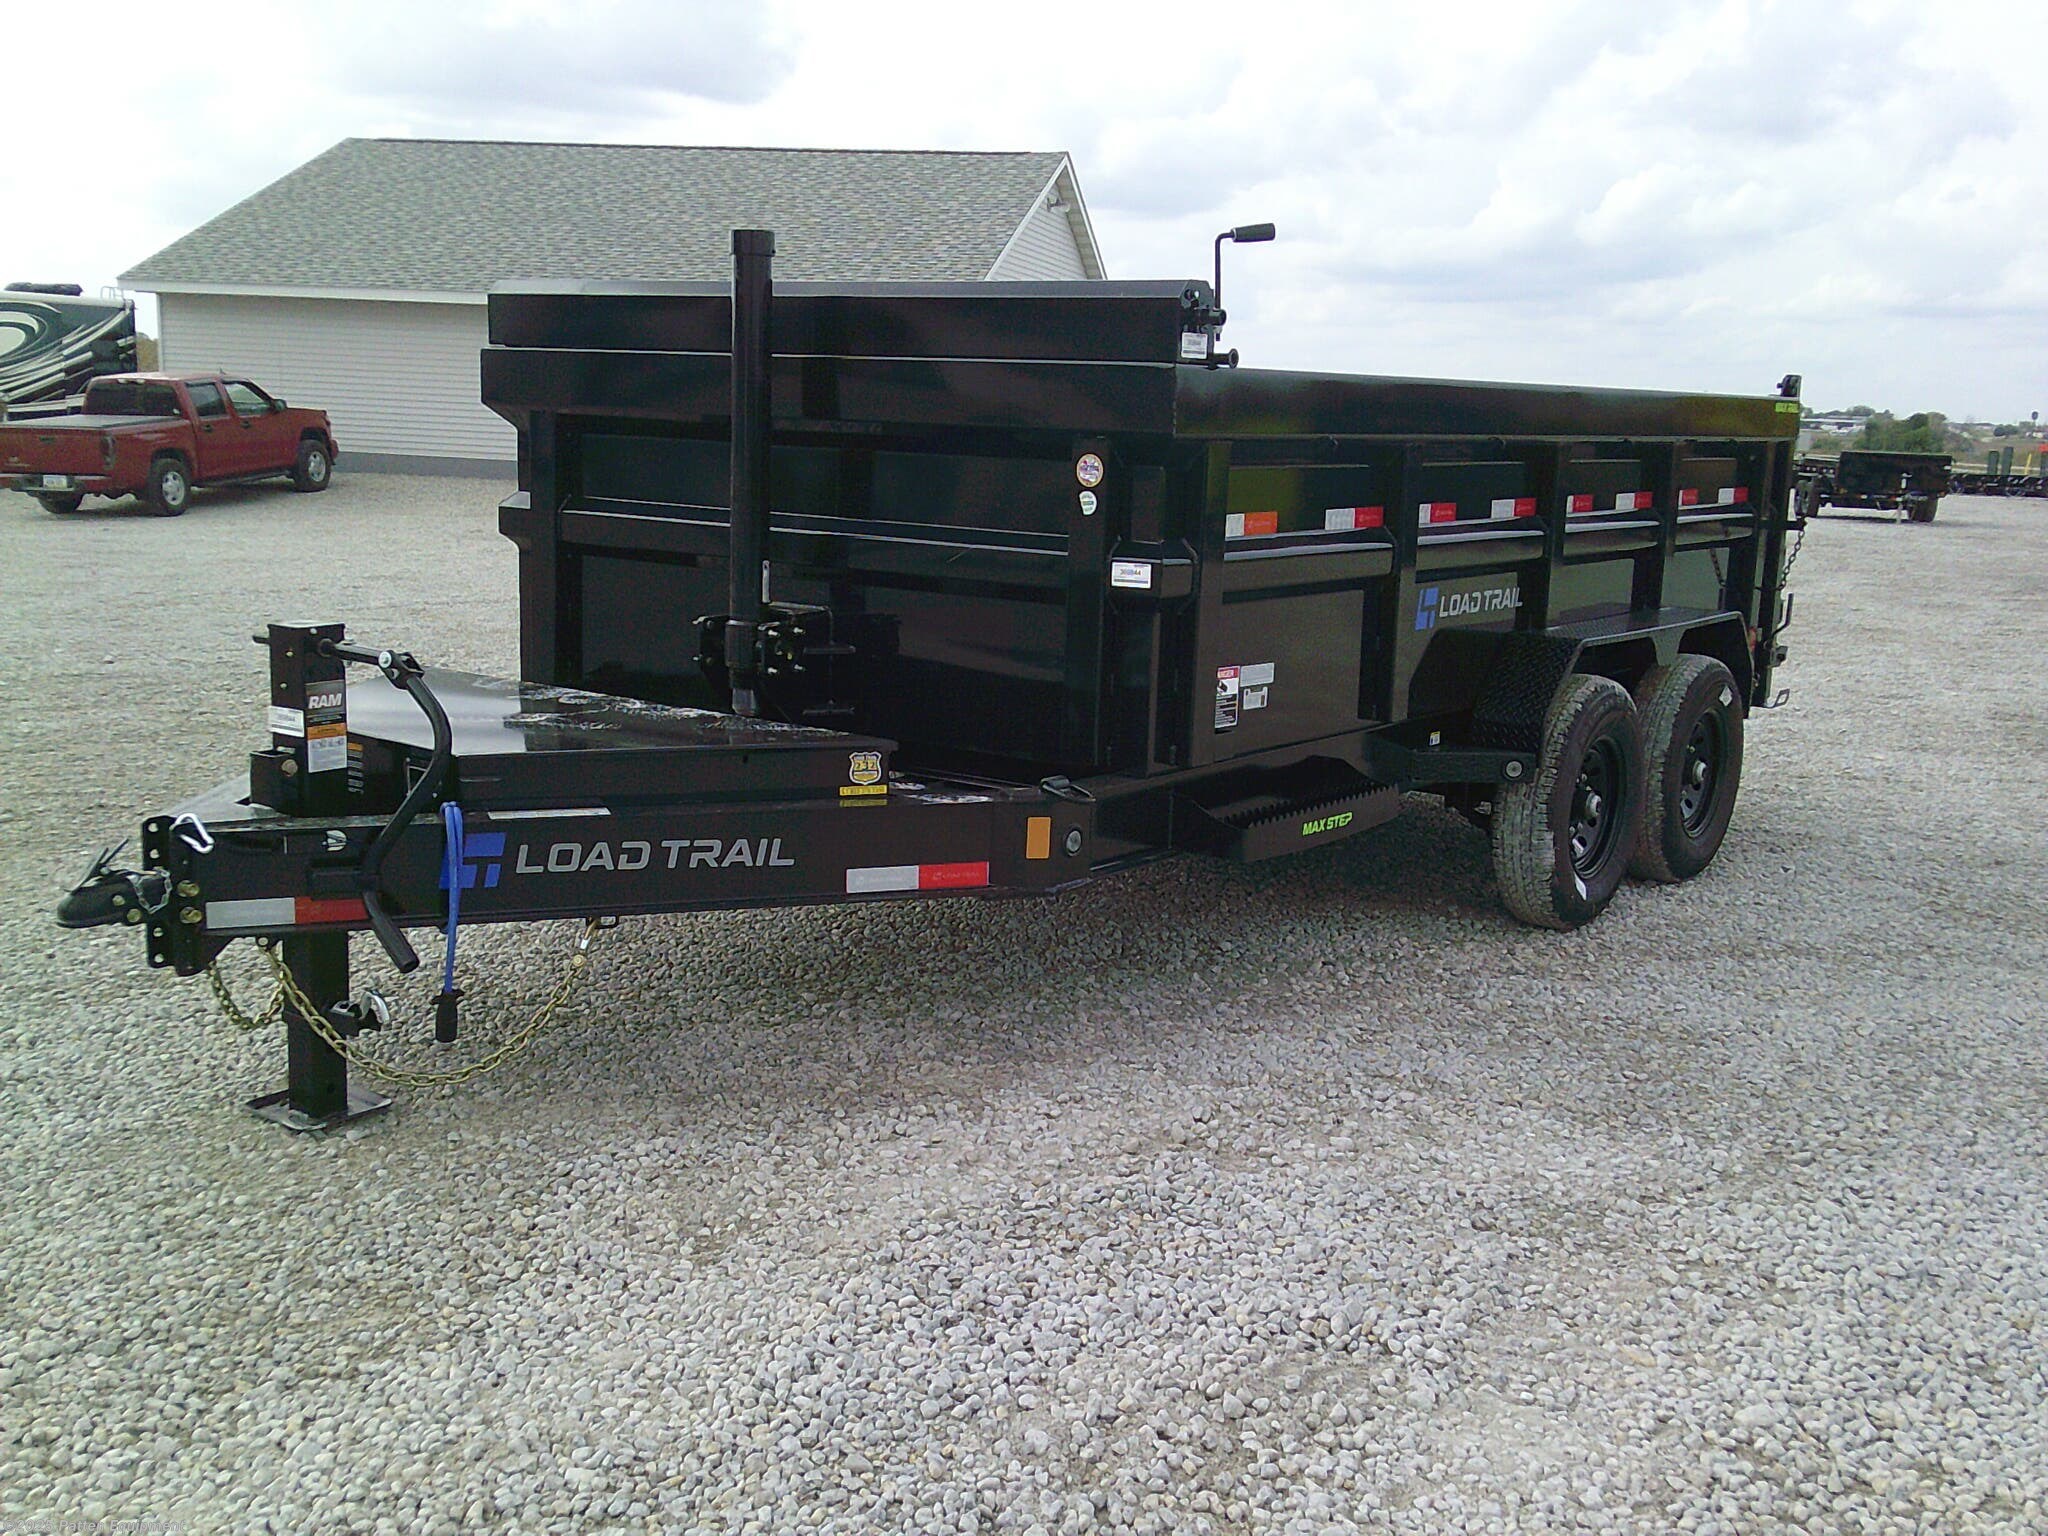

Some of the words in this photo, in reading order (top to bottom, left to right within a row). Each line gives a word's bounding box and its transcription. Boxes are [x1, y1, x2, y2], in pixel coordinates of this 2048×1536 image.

[1439, 592, 1481, 618] LOAD
[1484, 587, 1522, 611] TRAIL
[308, 693, 342, 709] RAM
[1302, 818, 1326, 836] MAX
[1326, 811, 1353, 830] STEP
[515, 840, 652, 874] LOAD
[661, 838, 796, 868] TRAIL
